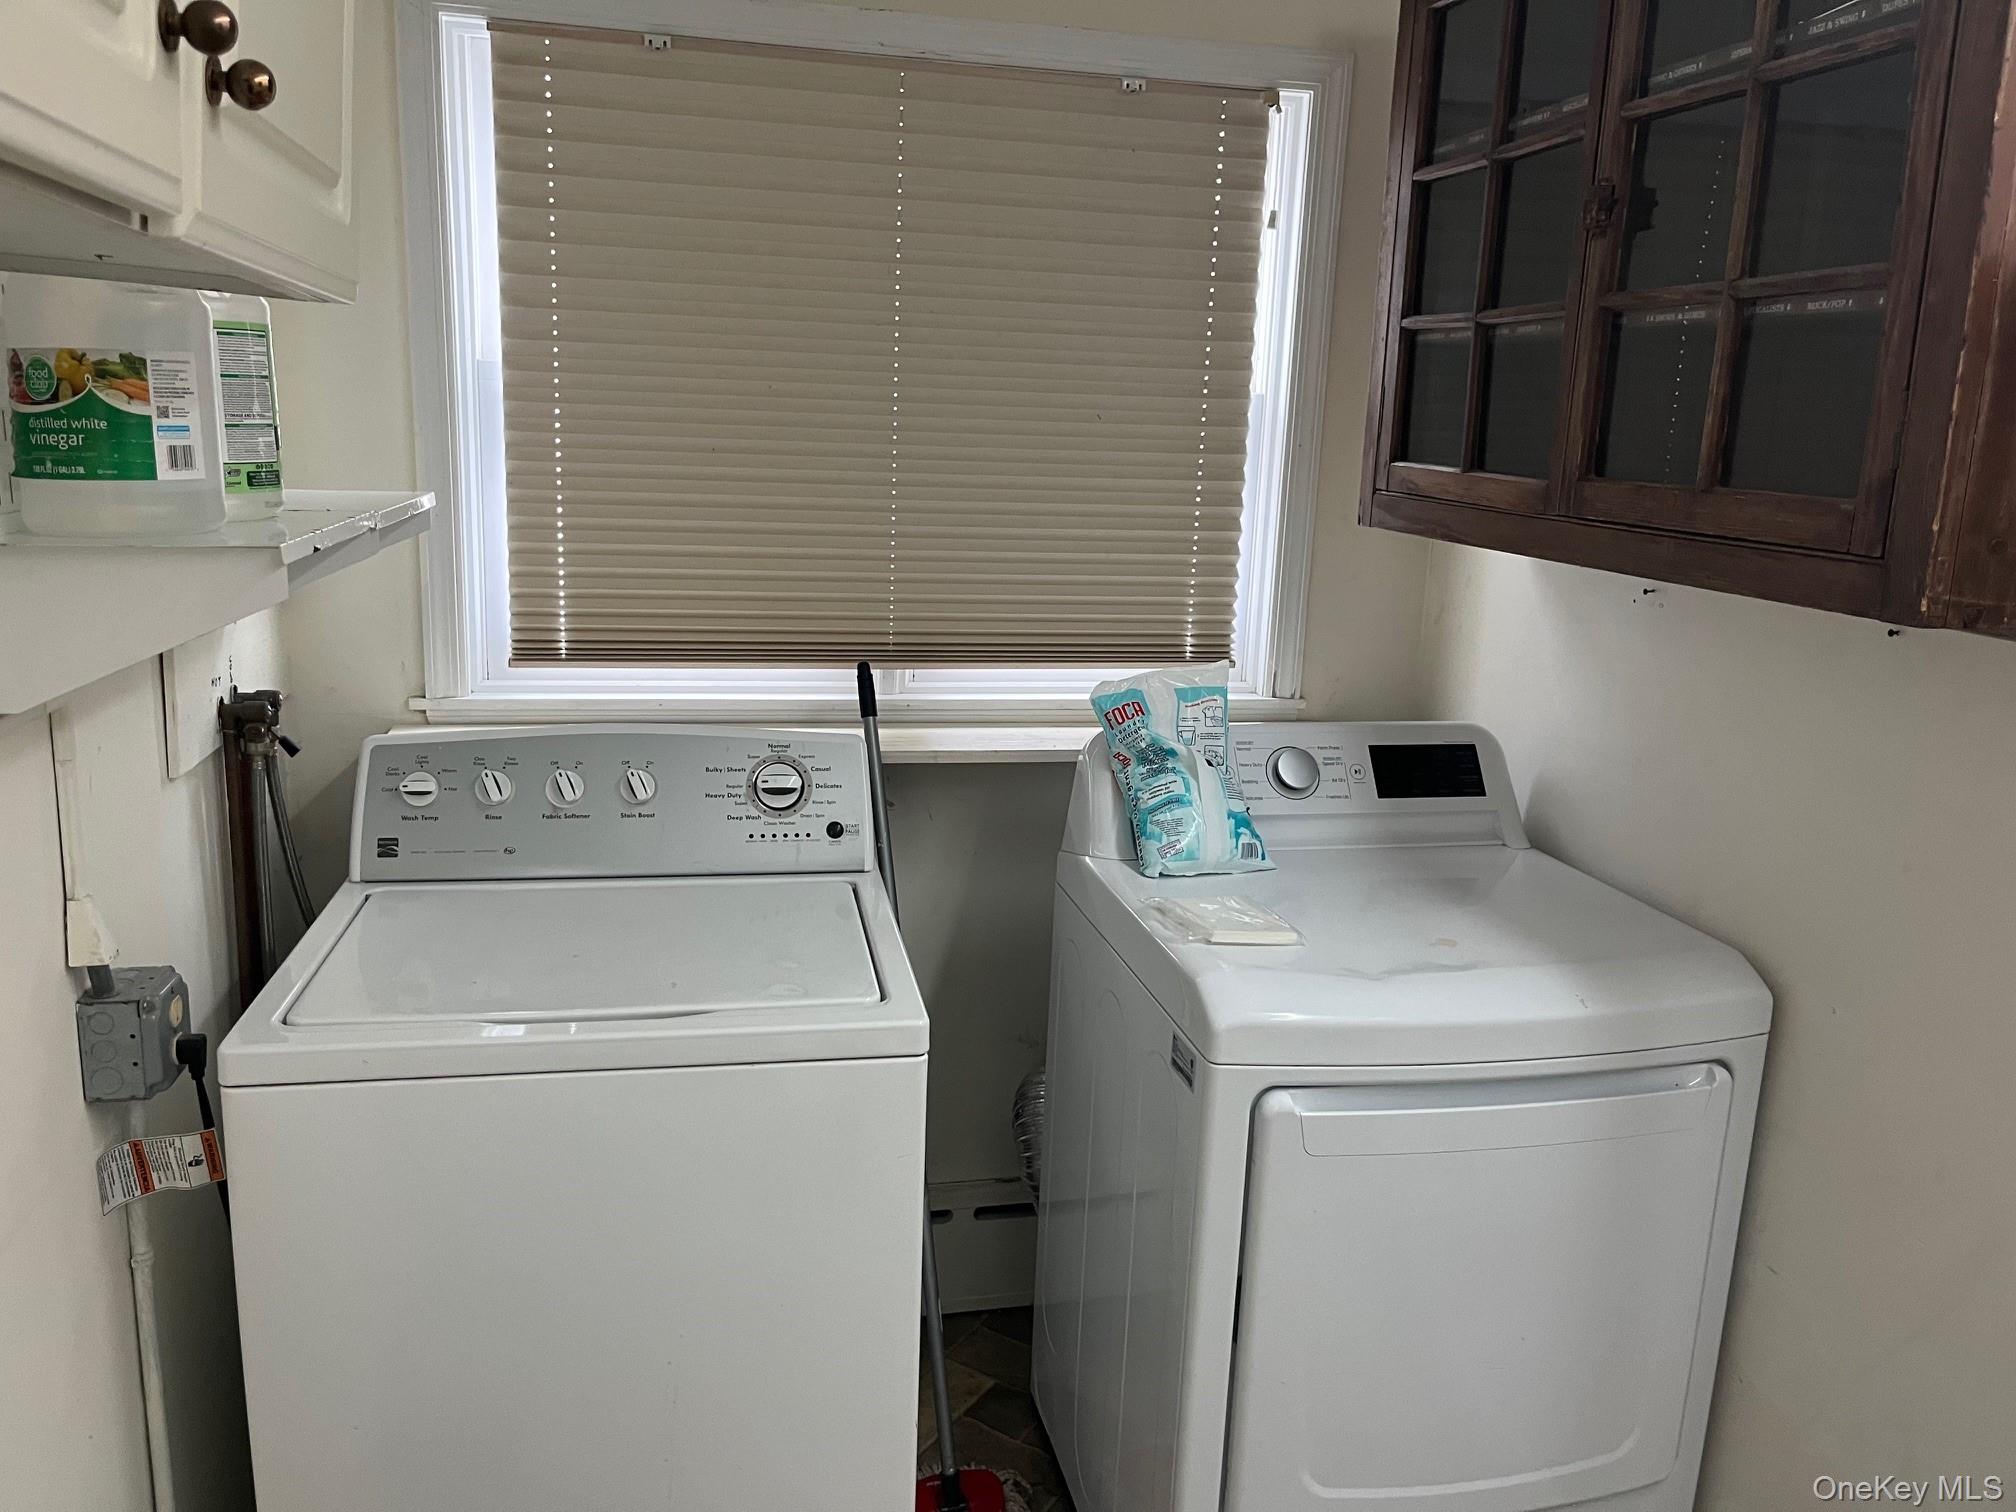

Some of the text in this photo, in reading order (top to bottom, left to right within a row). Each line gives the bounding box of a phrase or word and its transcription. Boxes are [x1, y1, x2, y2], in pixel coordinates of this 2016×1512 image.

[28, 366, 48, 378] food
[29, 416, 108, 430] distilled white
[29, 429, 86, 450] vinegar
[211, 676, 221, 687] HOT
[1104, 701, 1145, 731] FOCA
[1114, 717, 1145, 737] Laundry
